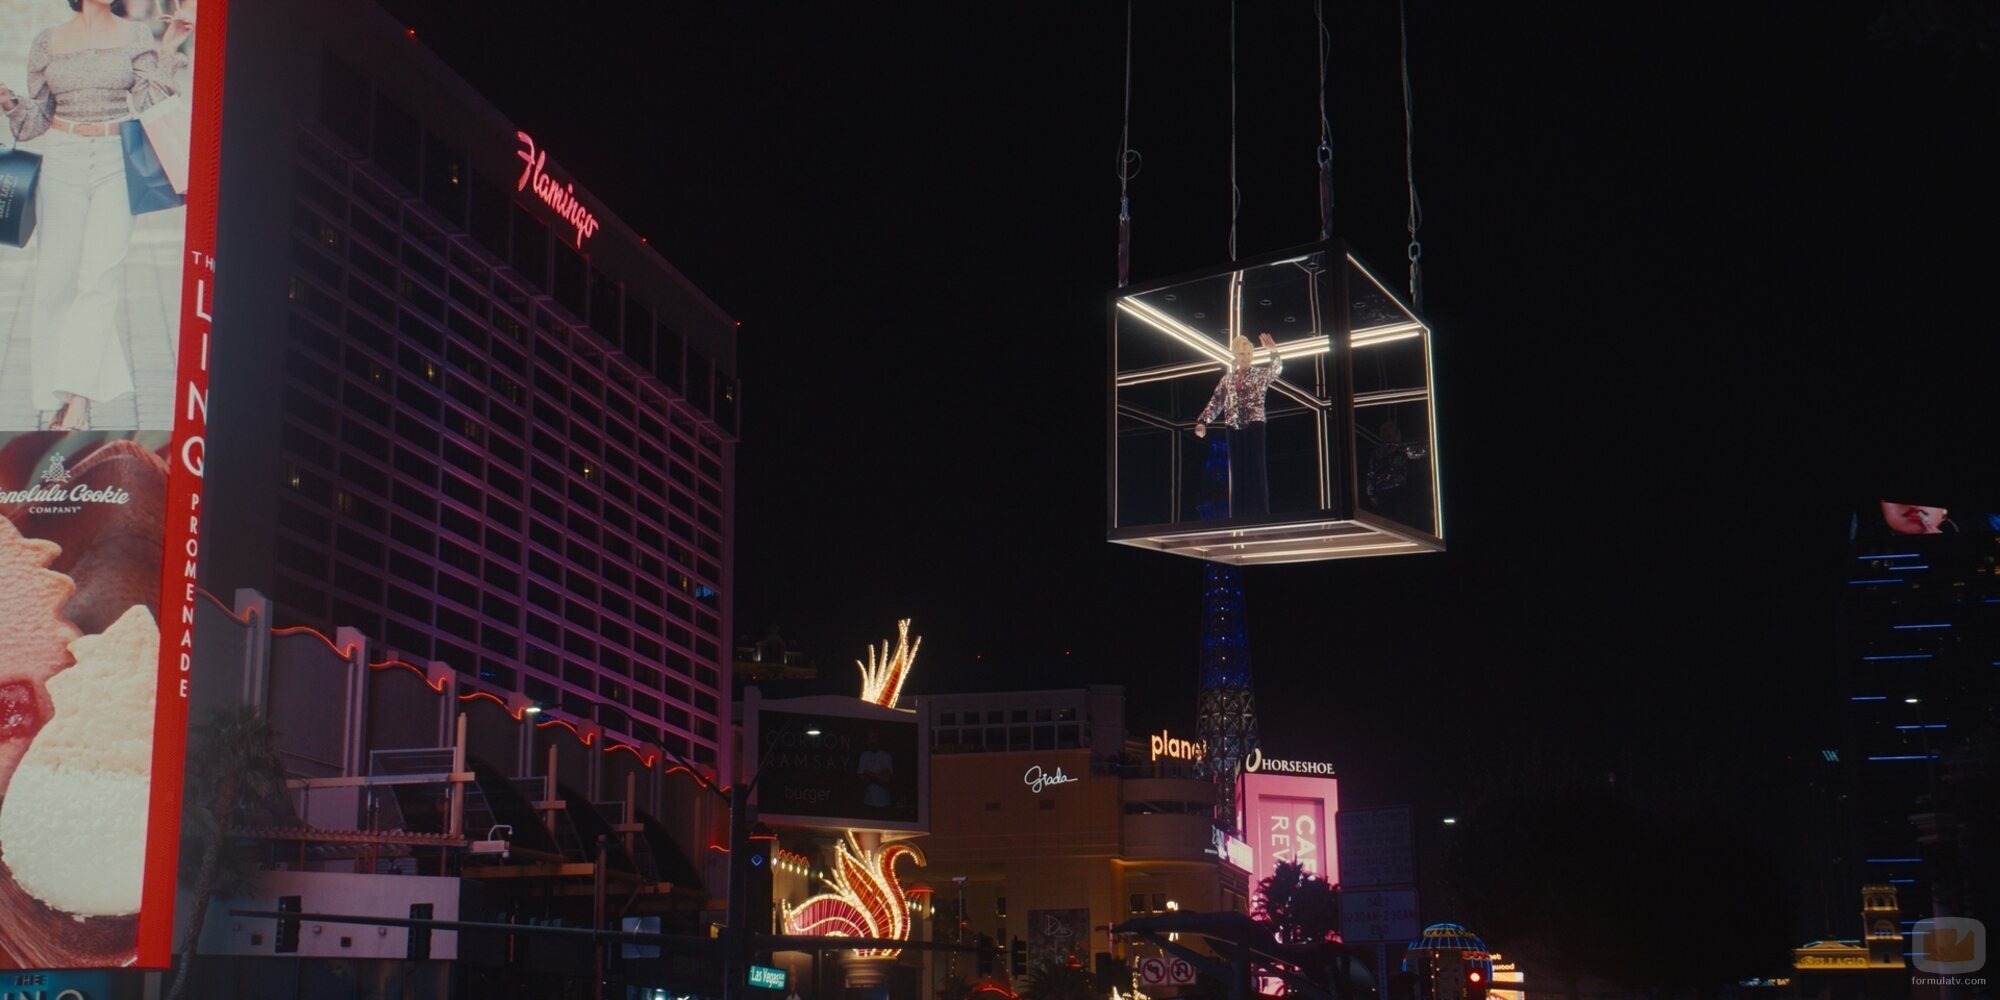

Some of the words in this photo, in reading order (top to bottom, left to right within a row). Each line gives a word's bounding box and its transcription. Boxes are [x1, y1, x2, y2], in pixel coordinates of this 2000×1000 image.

[516, 130, 599, 249] Flamingo
[192, 250, 215, 272] TH
[0, 484, 67, 504] onolulu
[70, 484, 130, 504] Cookie
[29, 506, 77, 514] COMPANY
[179, 493, 200, 698] PROMENADE
[1262, 758, 1334, 774] HORSESHOE
[1024, 765, 1078, 793] Giada
[785, 785, 833, 804] burger
